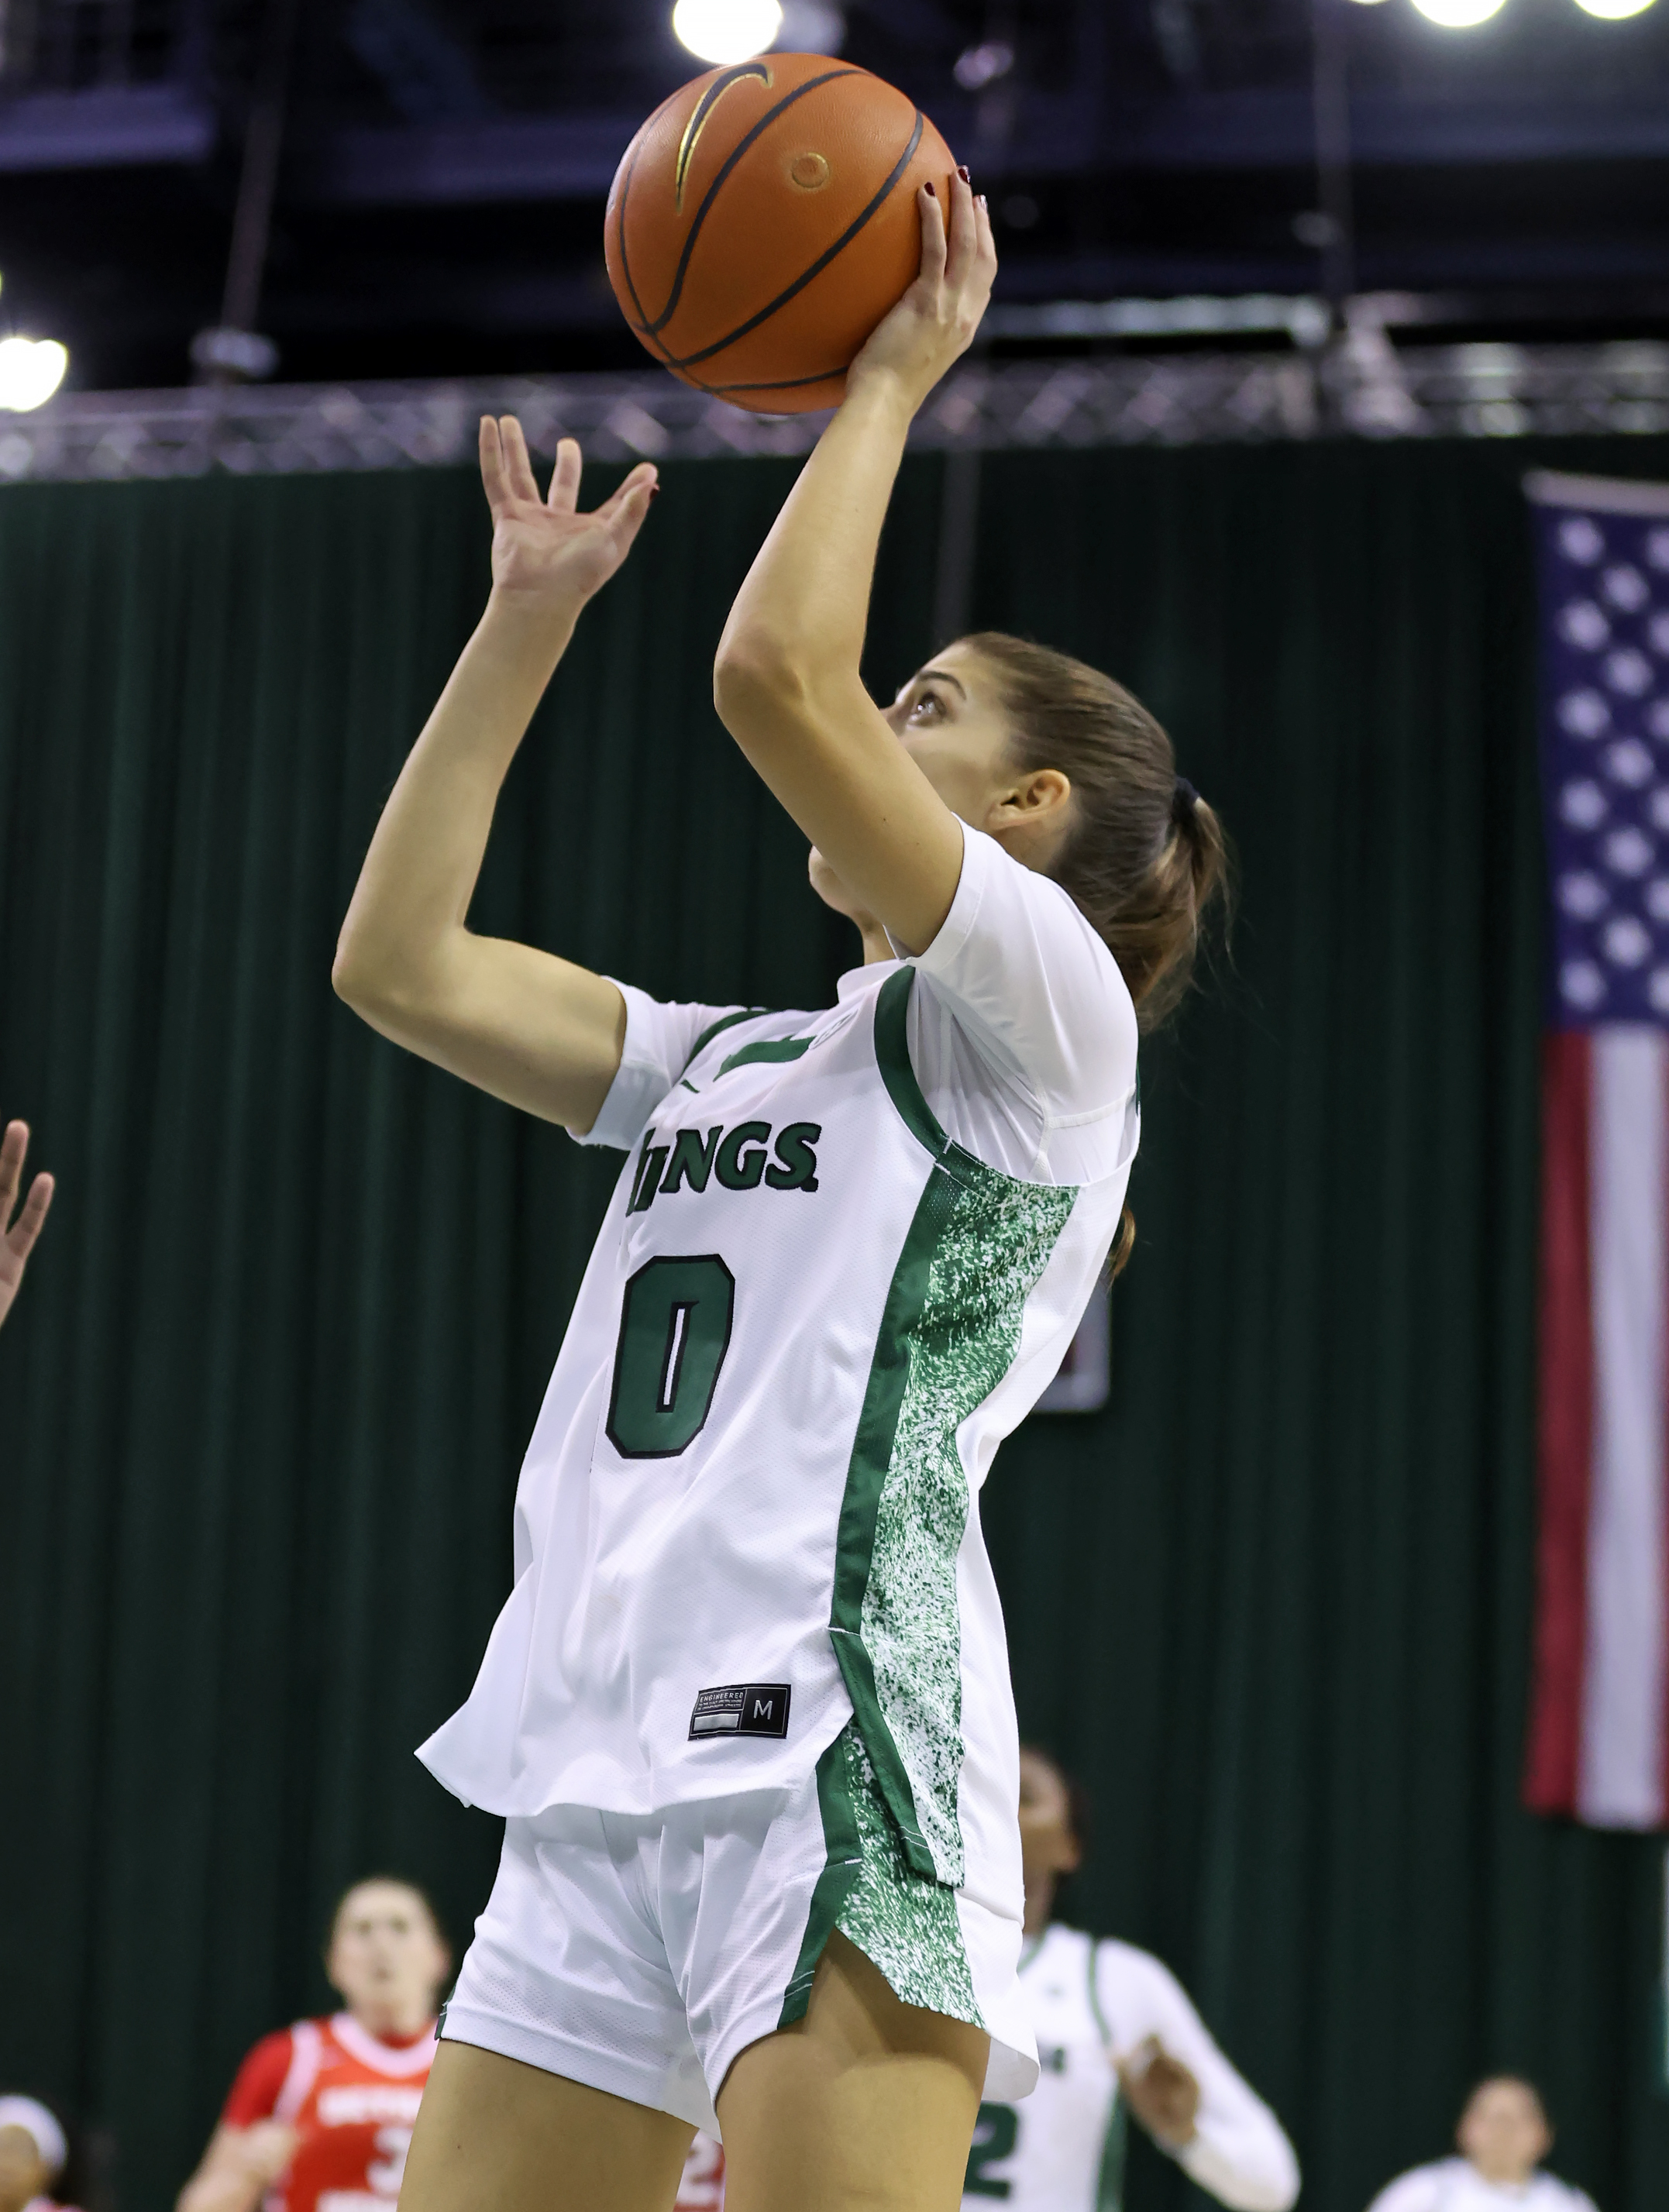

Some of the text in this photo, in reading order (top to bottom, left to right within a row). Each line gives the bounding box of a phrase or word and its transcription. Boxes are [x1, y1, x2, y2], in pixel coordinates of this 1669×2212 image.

[626, 1121, 822, 1217] INGS
[605, 1254, 735, 1459] 0
[700, 1692, 744, 1703] ENGINEERED
[753, 1700, 773, 1720] M
[963, 2100, 1020, 2199] 2
